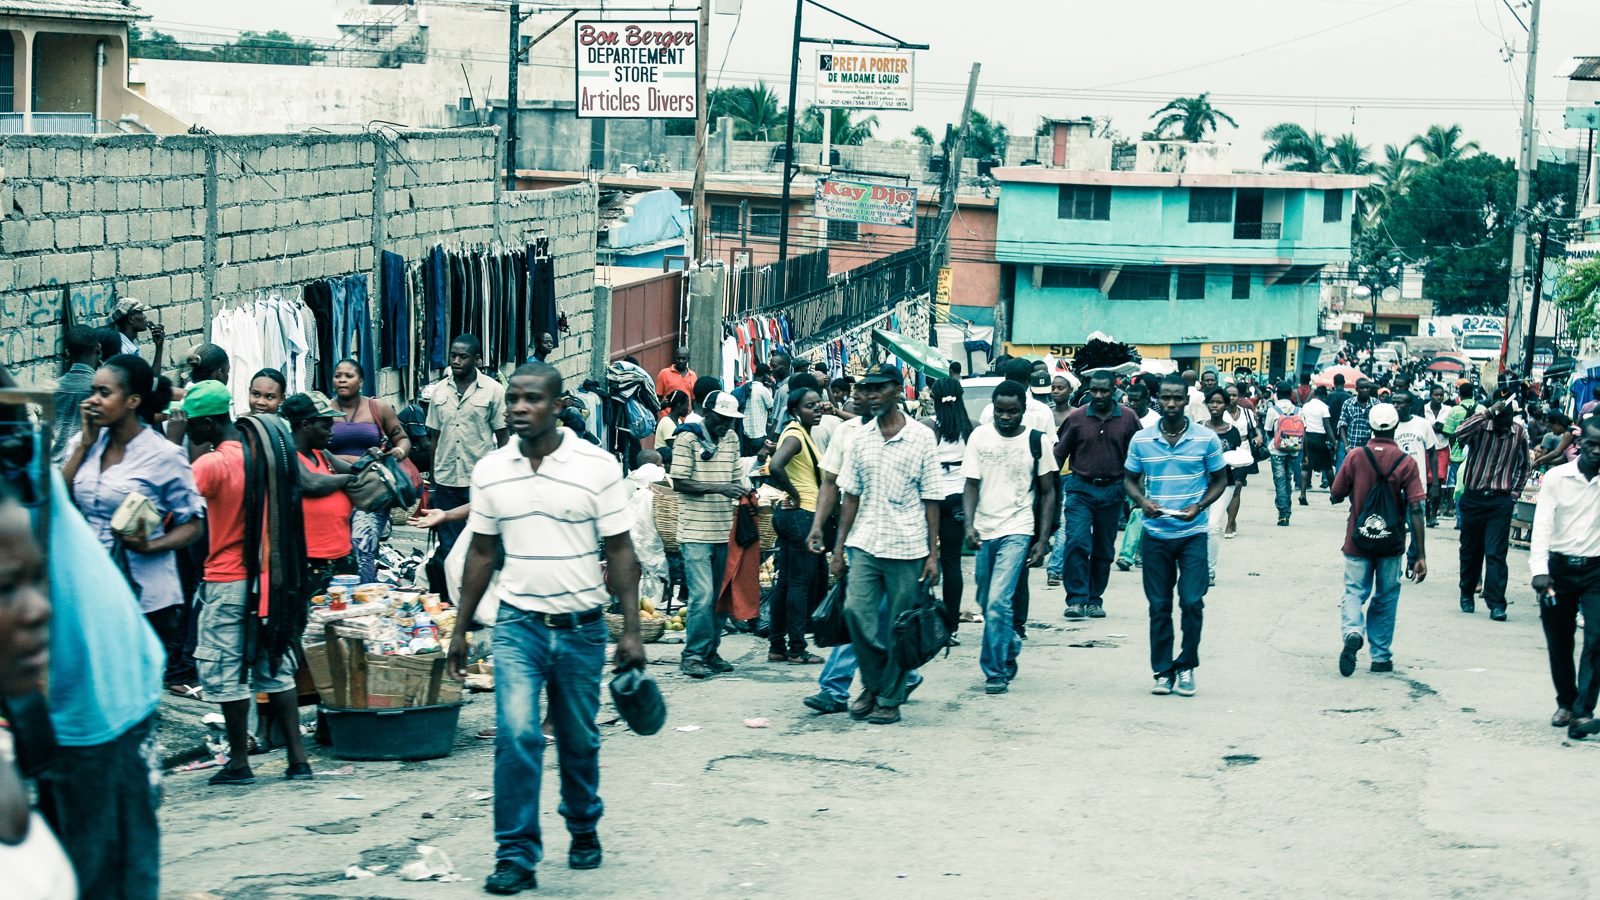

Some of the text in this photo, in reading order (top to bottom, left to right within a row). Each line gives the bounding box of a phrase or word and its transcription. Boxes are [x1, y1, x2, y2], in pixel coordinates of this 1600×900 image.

[579, 24, 695, 54] Bon Berger
[588, 47, 685, 64] DEPARTEMENT
[833, 56, 908, 73] PRET A PORTER
[614, 66, 659, 83] STORE
[828, 72, 900, 84] DE MADAME LOUIS
[581, 86, 694, 112] Articles Divers
[823, 181, 910, 205] Kay Djo
[822, 198, 858, 207] Provision
[1211, 343, 1255, 354] SUPER
